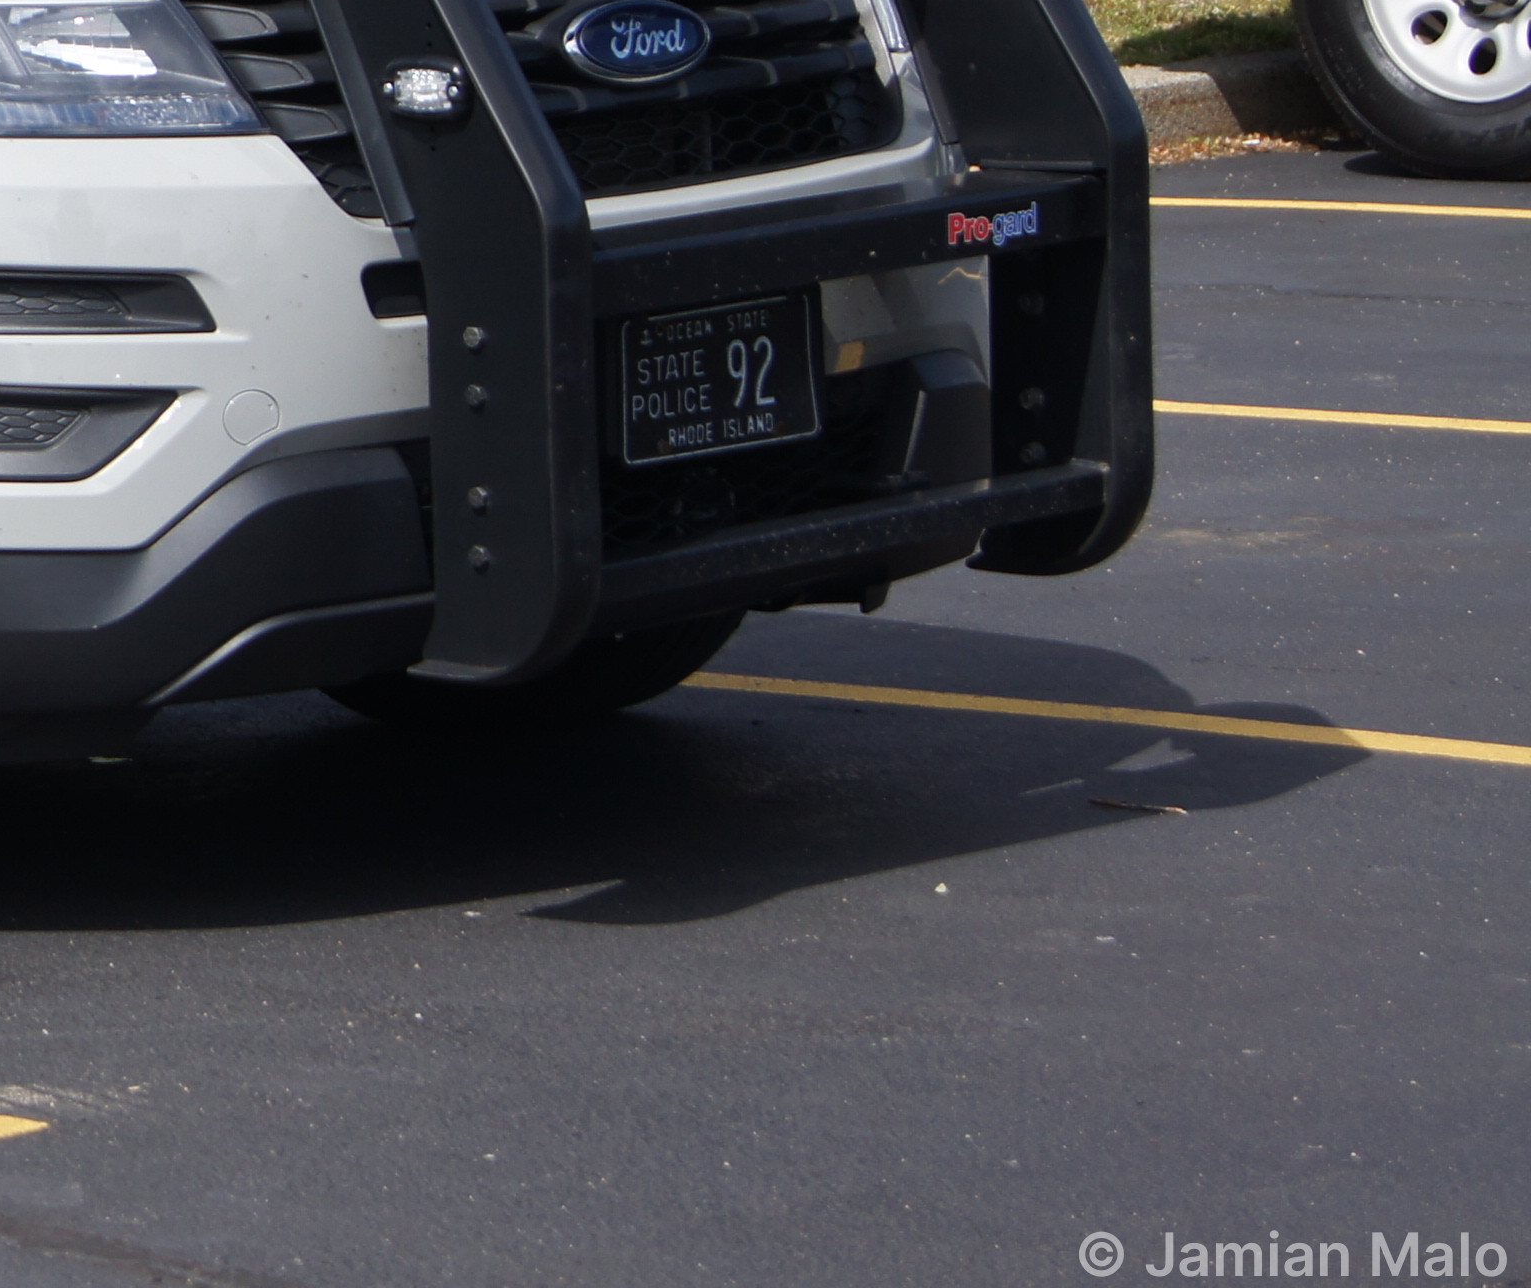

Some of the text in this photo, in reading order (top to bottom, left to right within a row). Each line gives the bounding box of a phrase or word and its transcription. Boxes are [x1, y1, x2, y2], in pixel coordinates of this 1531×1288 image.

[611, 17, 687, 59] Ford
[947, 200, 1037, 246] Pro-gard
[666, 310, 768, 342] OCEAN STATE
[637, 335, 777, 408] STATE 92
[631, 383, 713, 421] POLICE
[668, 413, 775, 447] RHODE ISLAND
